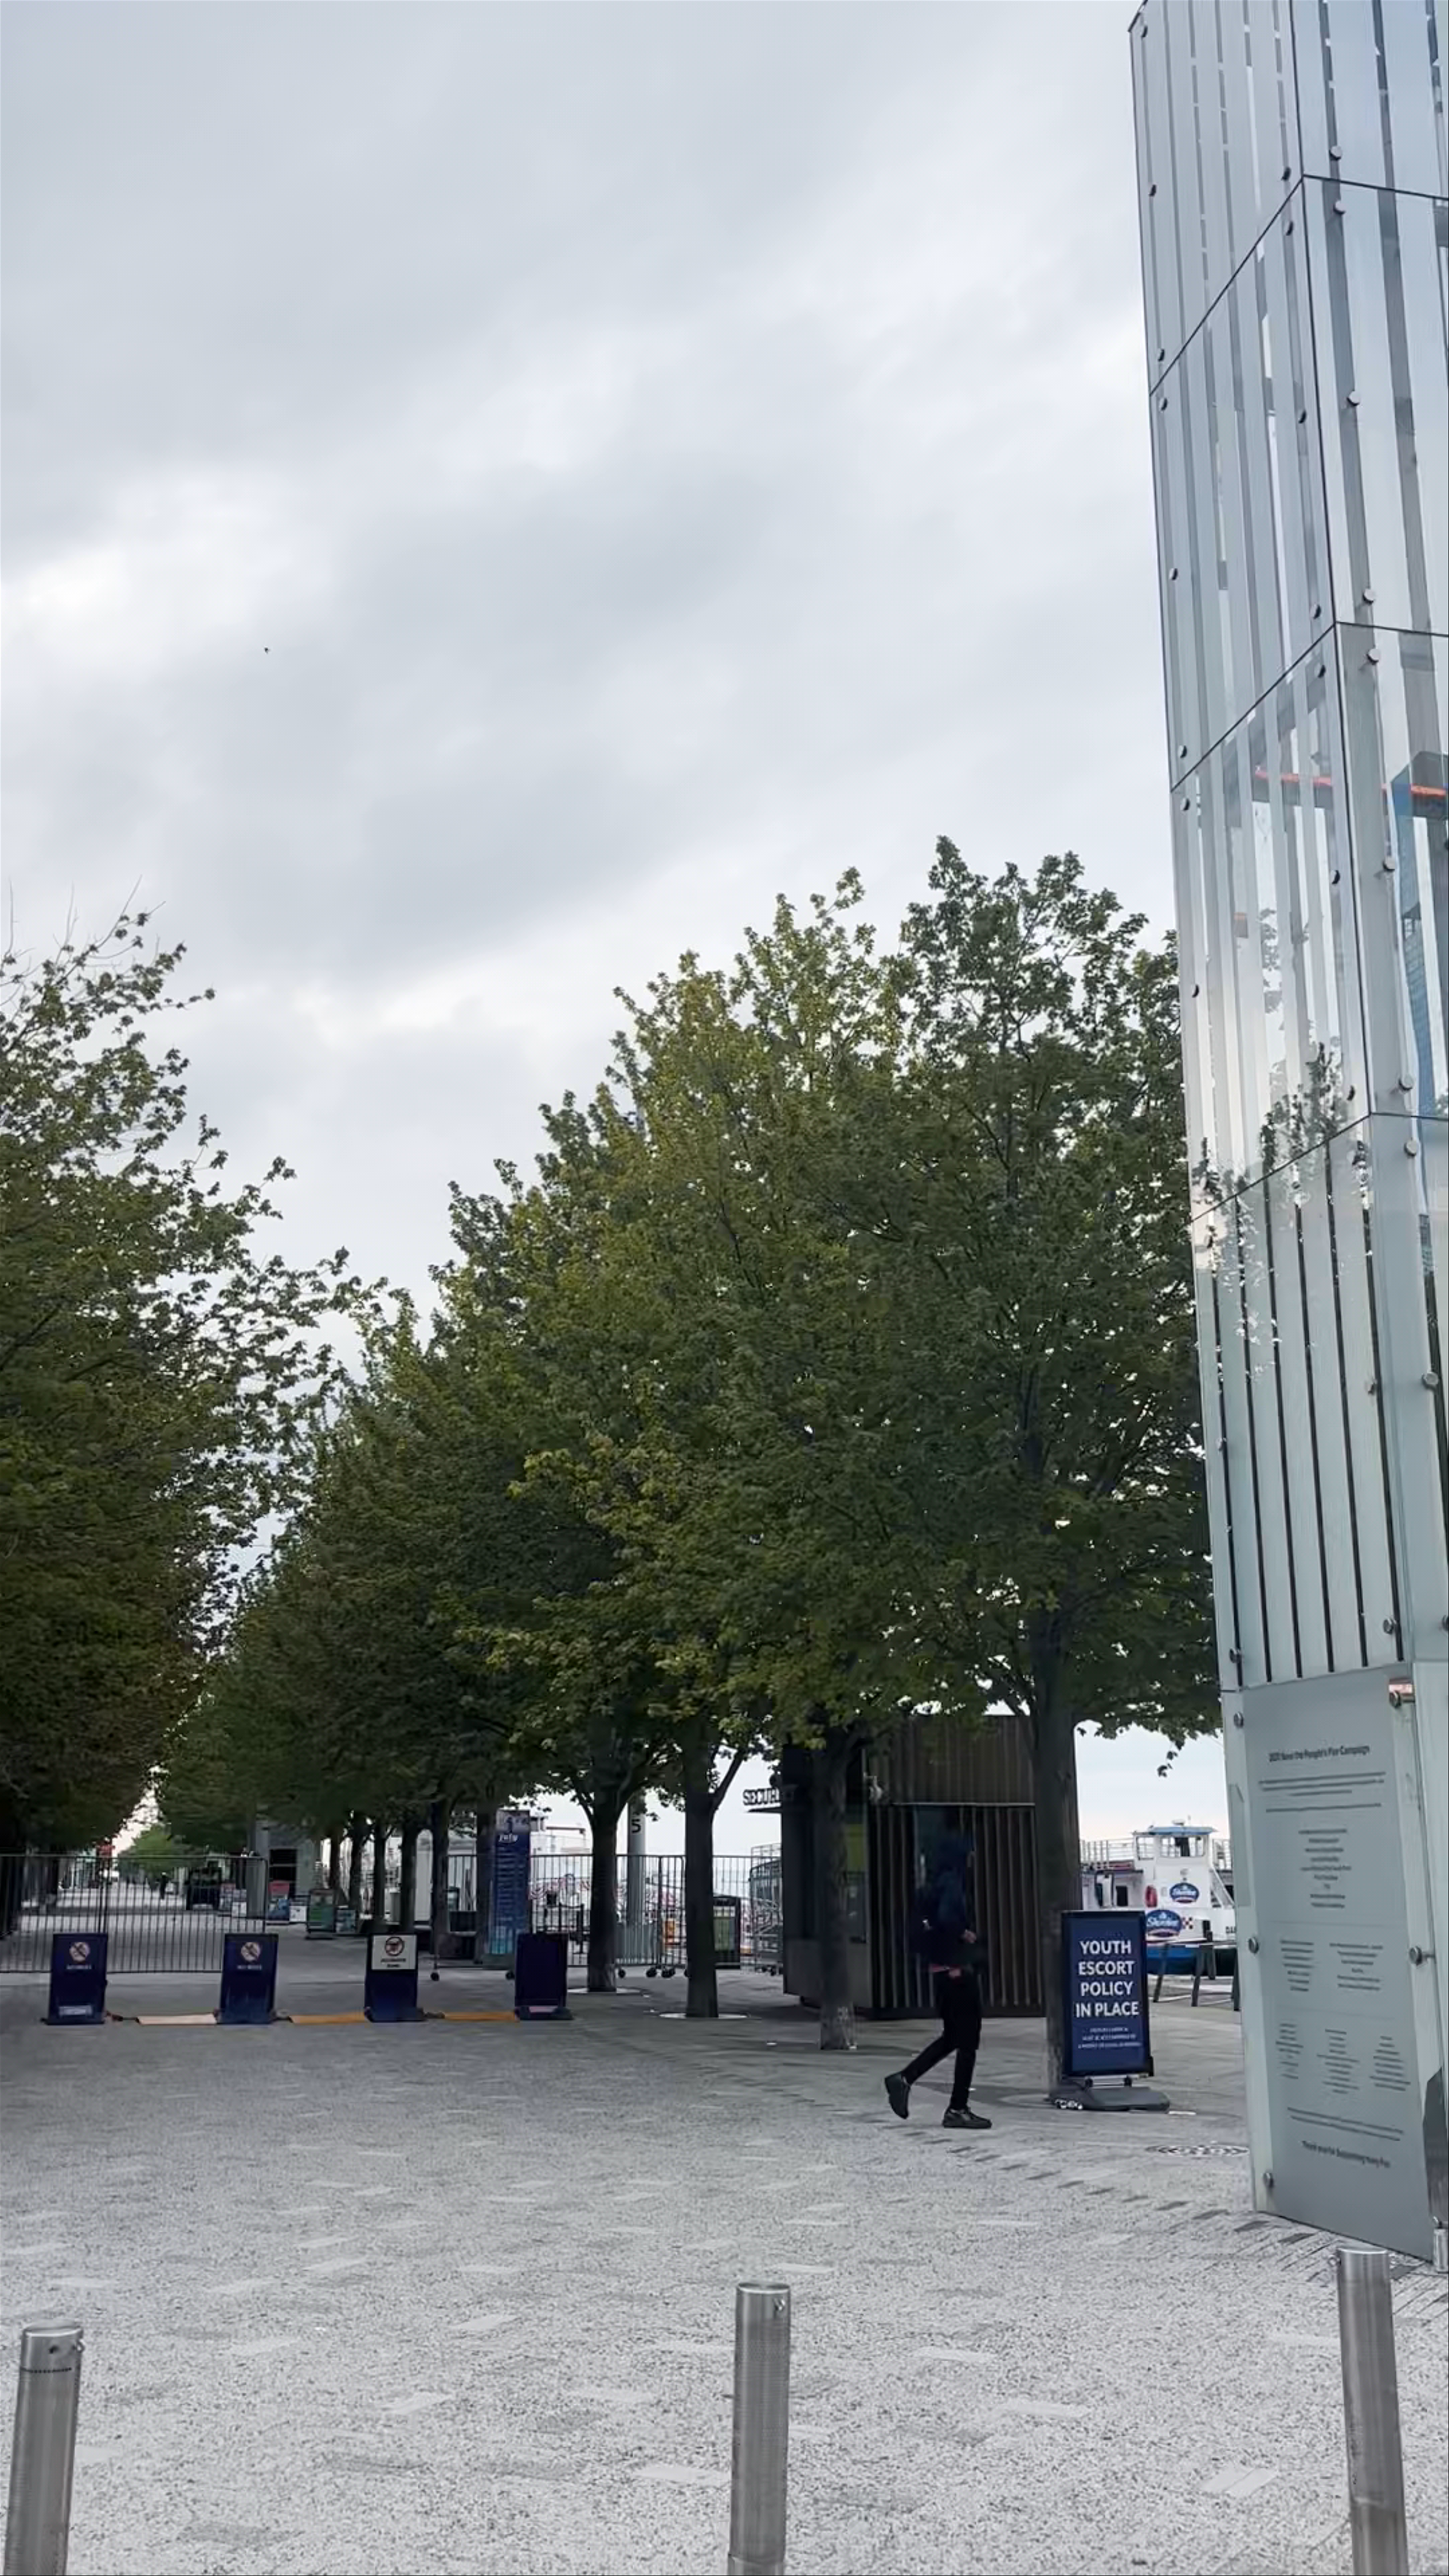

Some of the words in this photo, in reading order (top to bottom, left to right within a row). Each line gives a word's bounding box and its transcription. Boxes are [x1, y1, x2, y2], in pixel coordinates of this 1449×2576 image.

[631, 1819, 641, 1833] 5
[1080, 1940, 1131, 1955] YOUTH
[1078, 1961, 1134, 1975] ESCORT
[1080, 1981, 1134, 1996] POLICY
[1075, 2002, 1091, 2018] IN
[1095, 2001, 1140, 2017] PLACE
